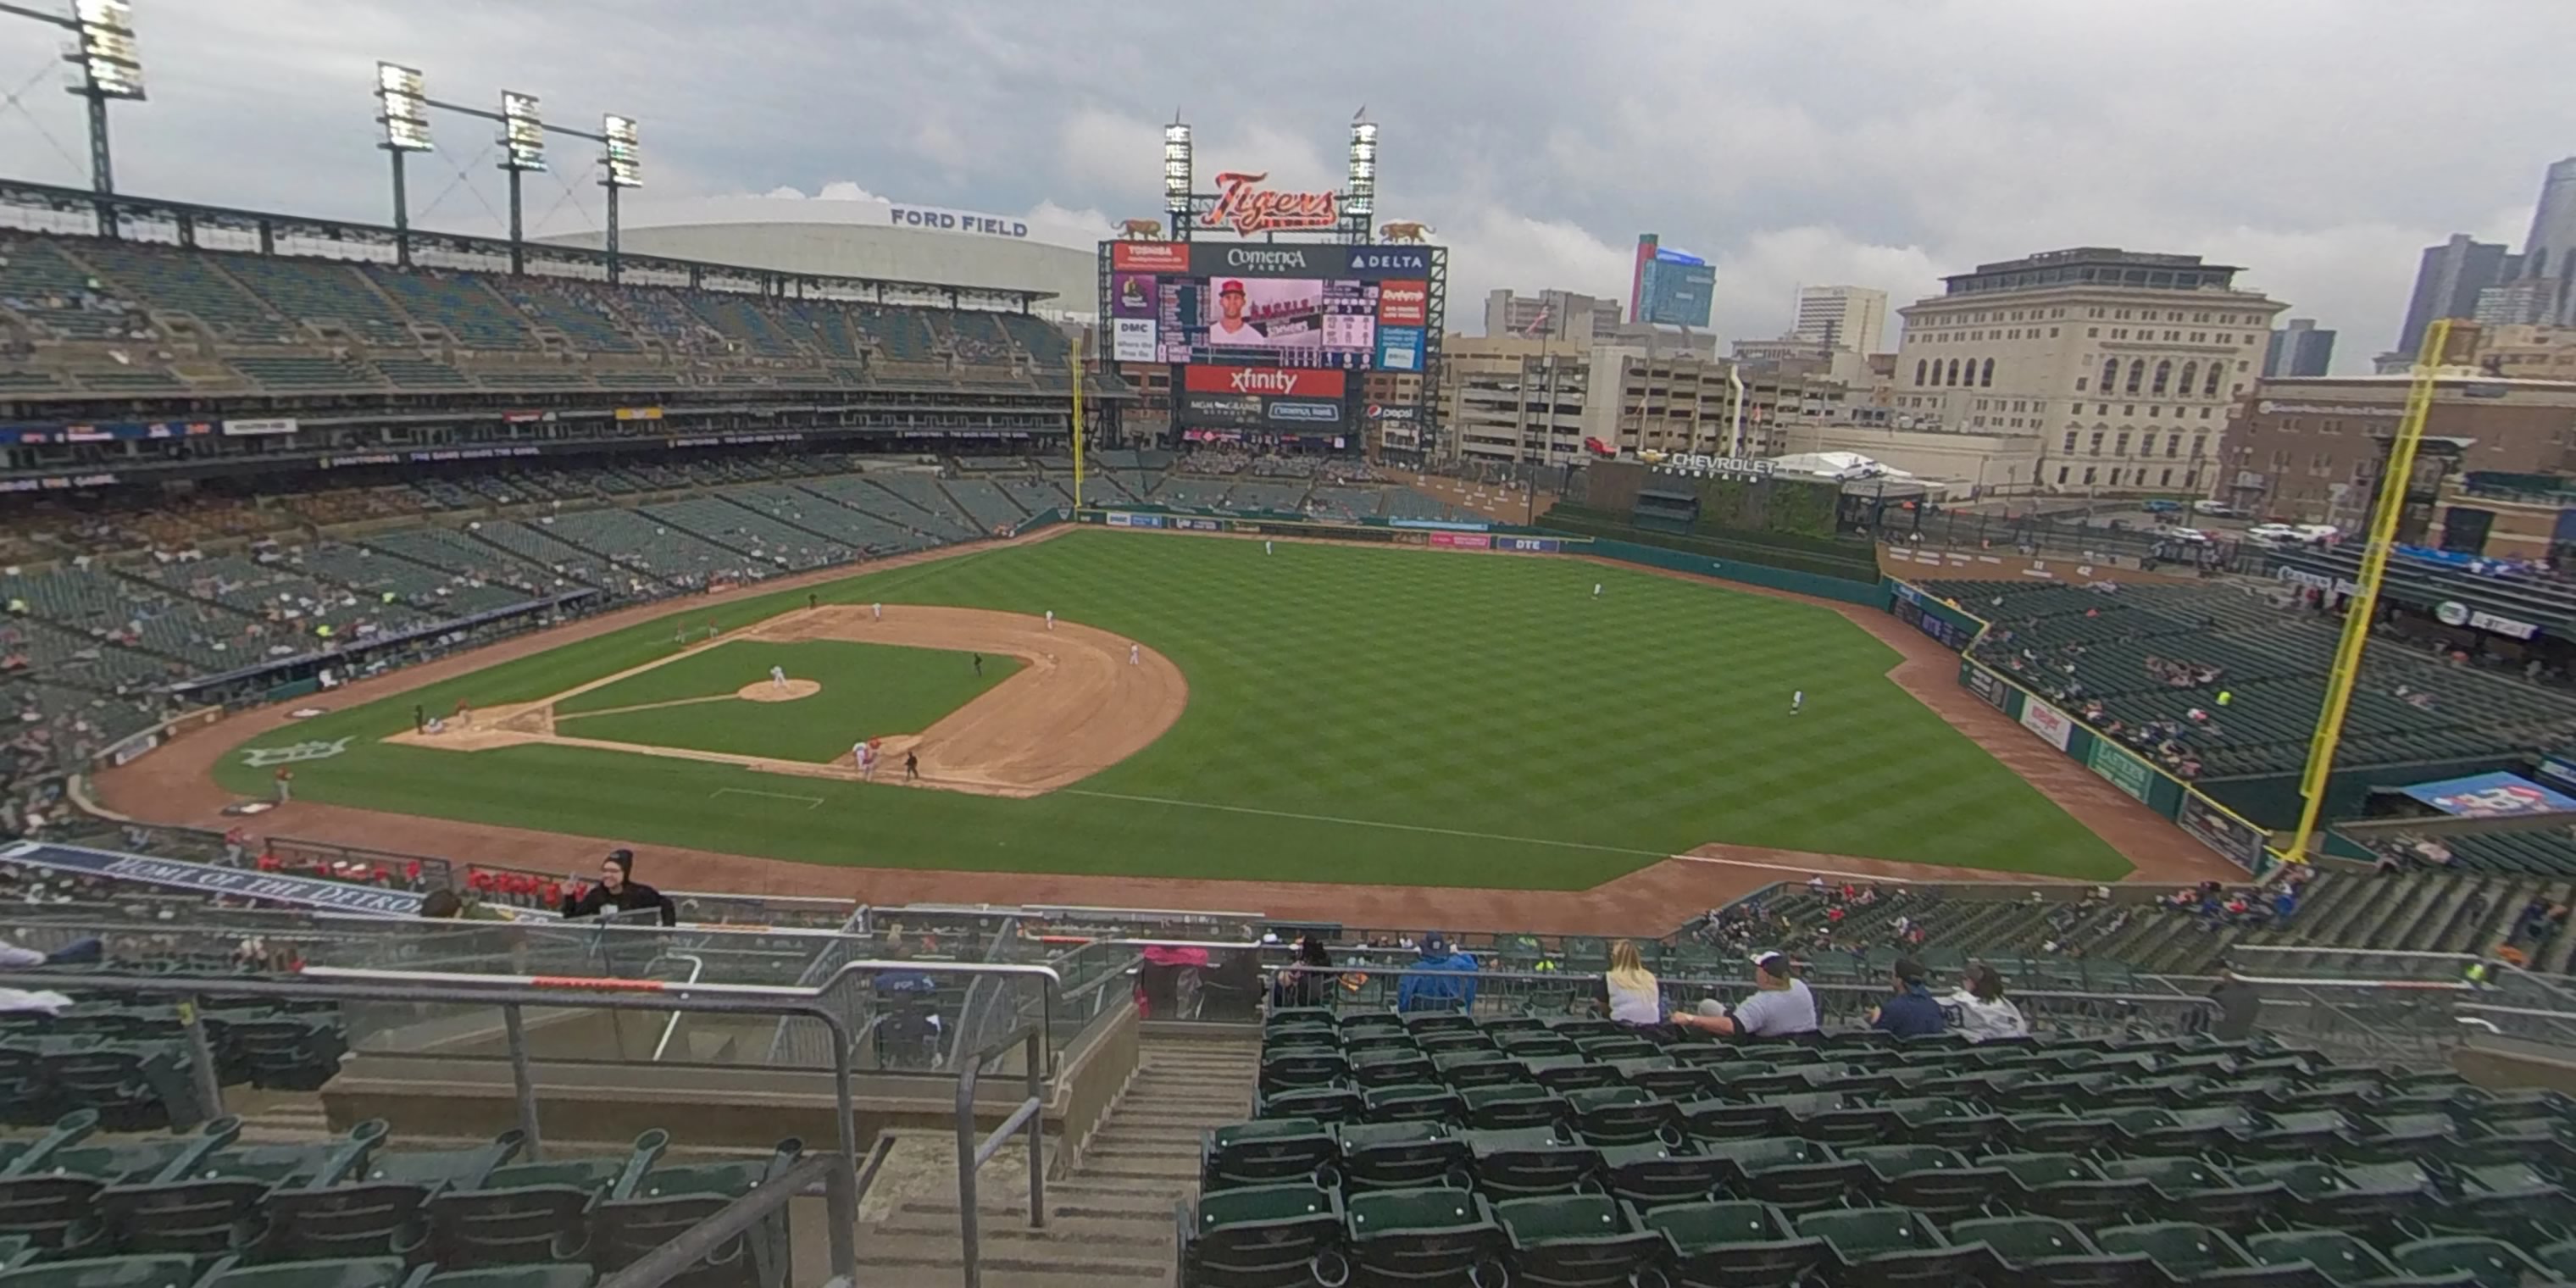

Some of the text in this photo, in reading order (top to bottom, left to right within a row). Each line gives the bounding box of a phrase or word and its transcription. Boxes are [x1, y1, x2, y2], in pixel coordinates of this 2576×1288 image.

[1201, 171, 1337, 237] Tigers
[891, 209, 1028, 237] FORD FIELD
[1368, 256, 1423, 267] DELTA
[1121, 323, 1148, 332] DMC
[1230, 368, 1298, 394] xfinity
[1383, 408, 1413, 418] pepsi
[1673, 453, 1776, 475] CHEVROLET
[1652, 466, 1757, 483] FOUNTAIN
[1516, 540, 1540, 550] DTE
[103, 857, 193, 880] HOME
[197, 871, 246, 886] OF
[251, 878, 303, 897] THE
